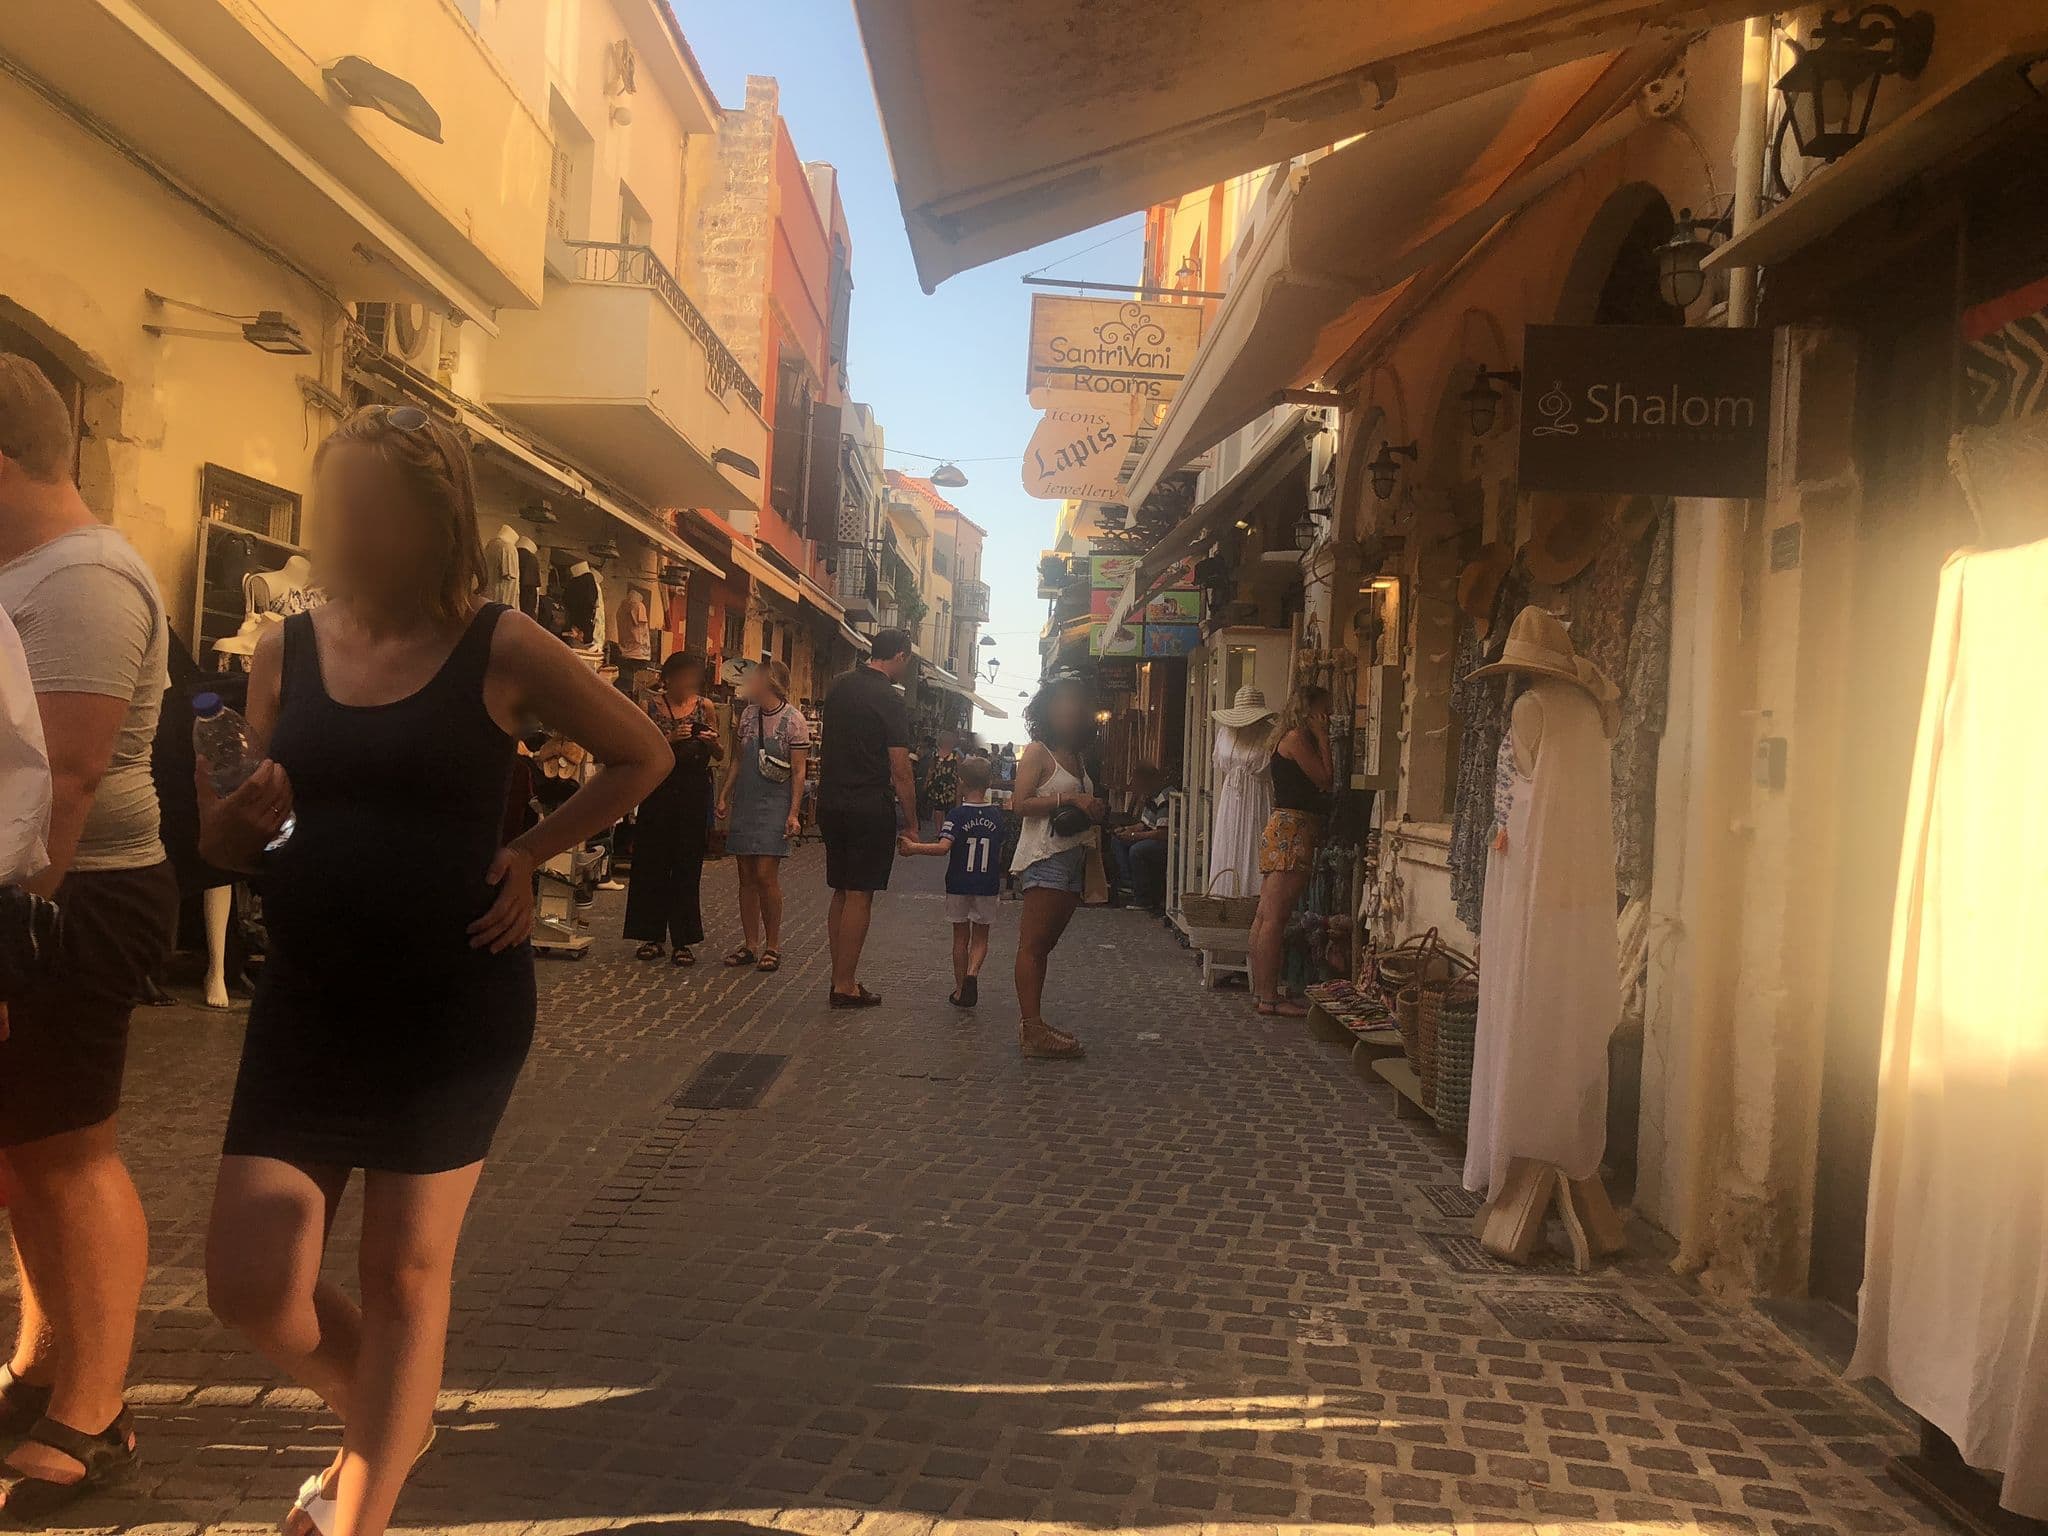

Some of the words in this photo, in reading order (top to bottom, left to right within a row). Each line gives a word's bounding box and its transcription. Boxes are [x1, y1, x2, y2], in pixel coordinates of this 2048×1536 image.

[1049, 336, 1171, 369] SantriVani
[1072, 365, 1162, 397] Rooms
[1586, 382, 1755, 427] Shalom
[1034, 421, 1118, 481] Lapis
[1042, 482, 1119, 500] jewellery
[961, 817, 997, 833] WALCOTT
[966, 837, 990, 873] 11
